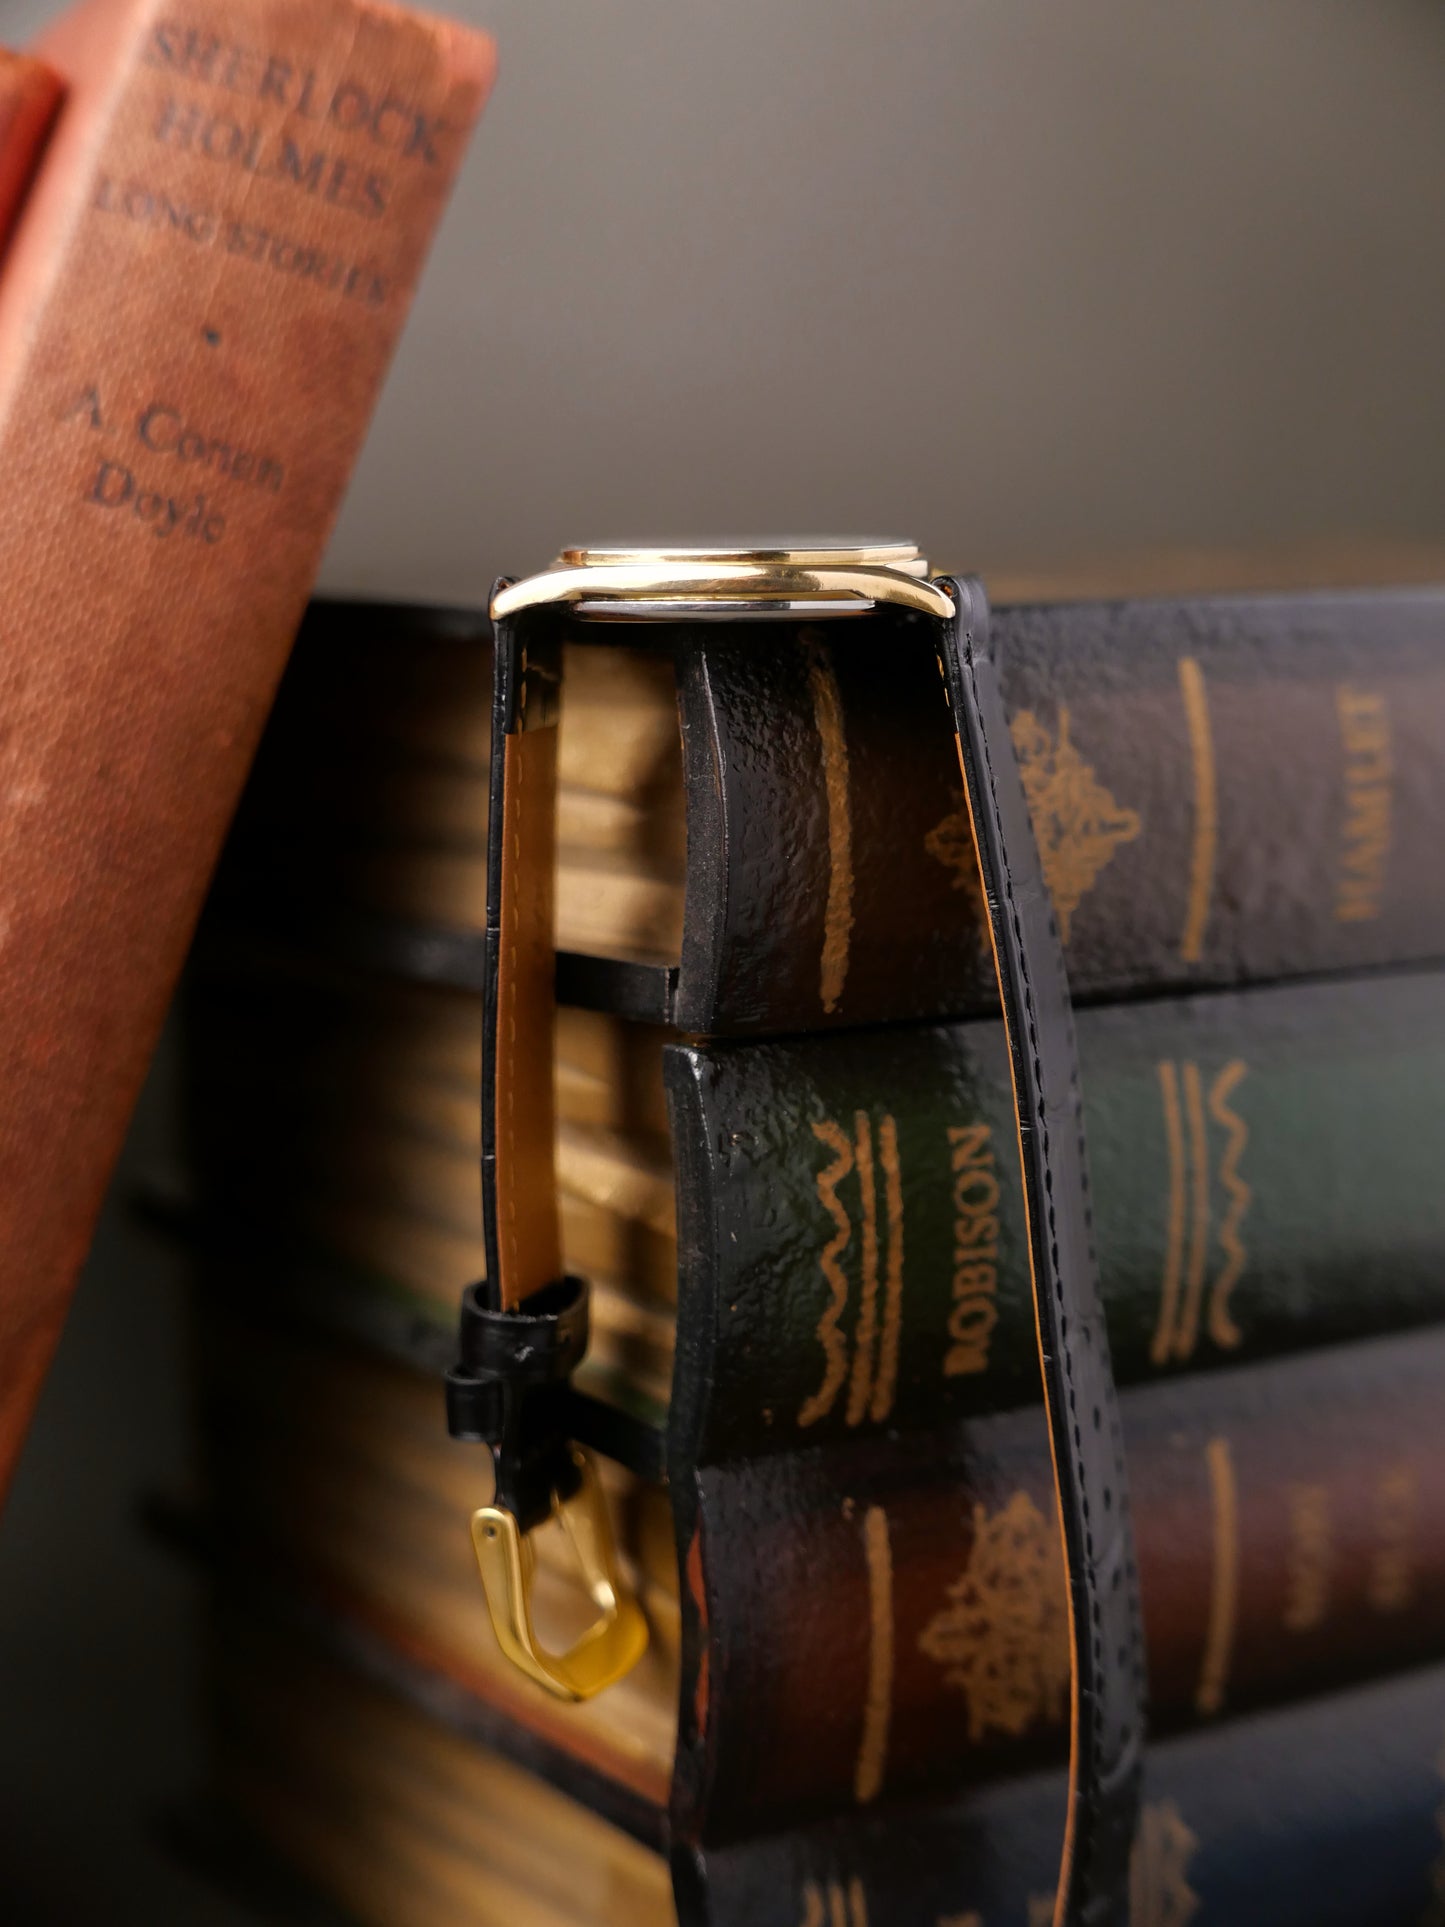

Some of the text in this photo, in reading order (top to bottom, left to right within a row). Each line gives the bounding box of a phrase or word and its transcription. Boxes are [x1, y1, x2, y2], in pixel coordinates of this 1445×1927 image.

[145, 23, 446, 166] SHERLOCK
[153, 95, 389, 220] HOLMES
[94, 174, 390, 307] LONG STORIES
[85, 456, 227, 545] Doyle
[137, 400, 285, 494] Conan
